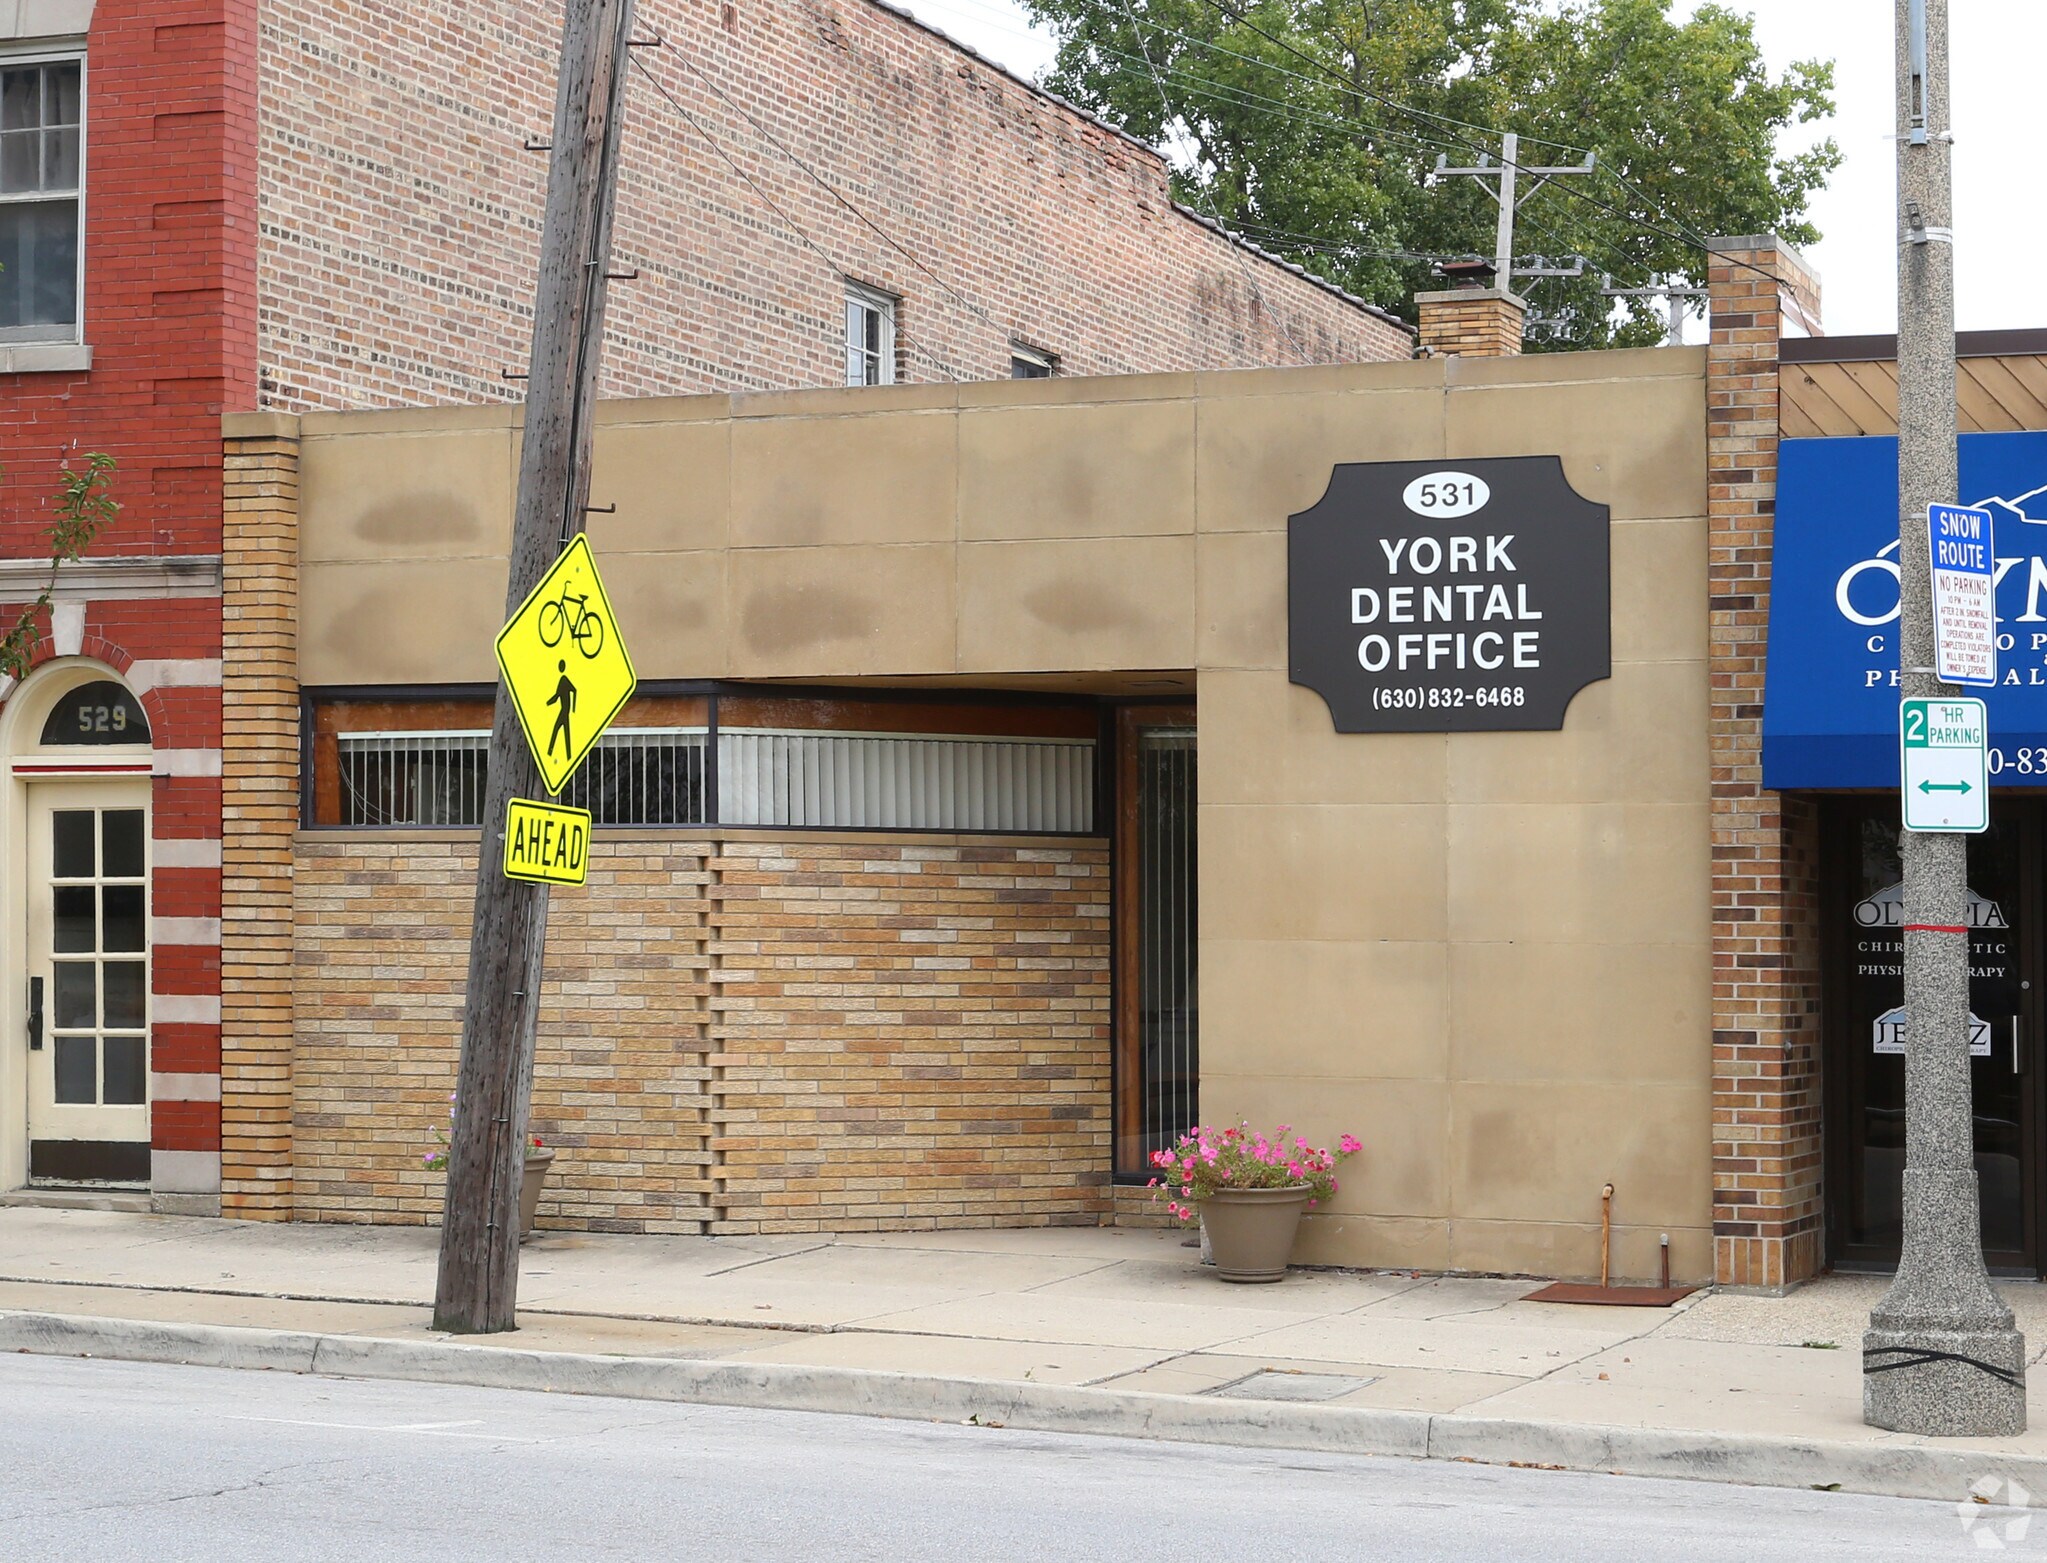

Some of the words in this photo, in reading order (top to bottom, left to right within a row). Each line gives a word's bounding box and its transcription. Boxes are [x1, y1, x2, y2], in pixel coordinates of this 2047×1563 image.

[1420, 482, 1474, 508] 531
[1940, 511, 1980, 540] SNOW
[1379, 534, 1517, 575] YORK
[1938, 540, 1985, 569] ROUTE
[1940, 575, 1951, 592] NO
[1954, 576, 1987, 596] PARKING
[1350, 583, 1543, 624] DENTAL
[1940, 606, 1955, 616] AFTER
[1966, 608, 1989, 620] SNOWFALL
[1954, 596, 1962, 605] PM
[1973, 598, 1981, 607] AM
[1942, 617, 1953, 627] AND
[1954, 618, 1967, 629] UNTIL
[1968, 620, 1988, 631] REMOVAL
[1946, 629, 1974, 640] OPERATIONS
[1975, 632, 1985, 642] ARE
[1357, 631, 1540, 673] OFFICE
[1940, 640, 1967, 651] COMPLETED
[1968, 642, 1992, 653] VIOLATORS
[1946, 652, 1957, 662] WILL
[1965, 653, 1980, 663] TOWED
[1967, 665, 1987, 676] EXPENSE
[1371, 686, 1525, 710] (630)832-6468
[78, 705, 126, 732] 529
[1906, 709, 1925, 741] 2
[1945, 707, 1964, 723] HR
[1930, 727, 1980, 744] PARKING
[511, 816, 583, 870] AHEAD
